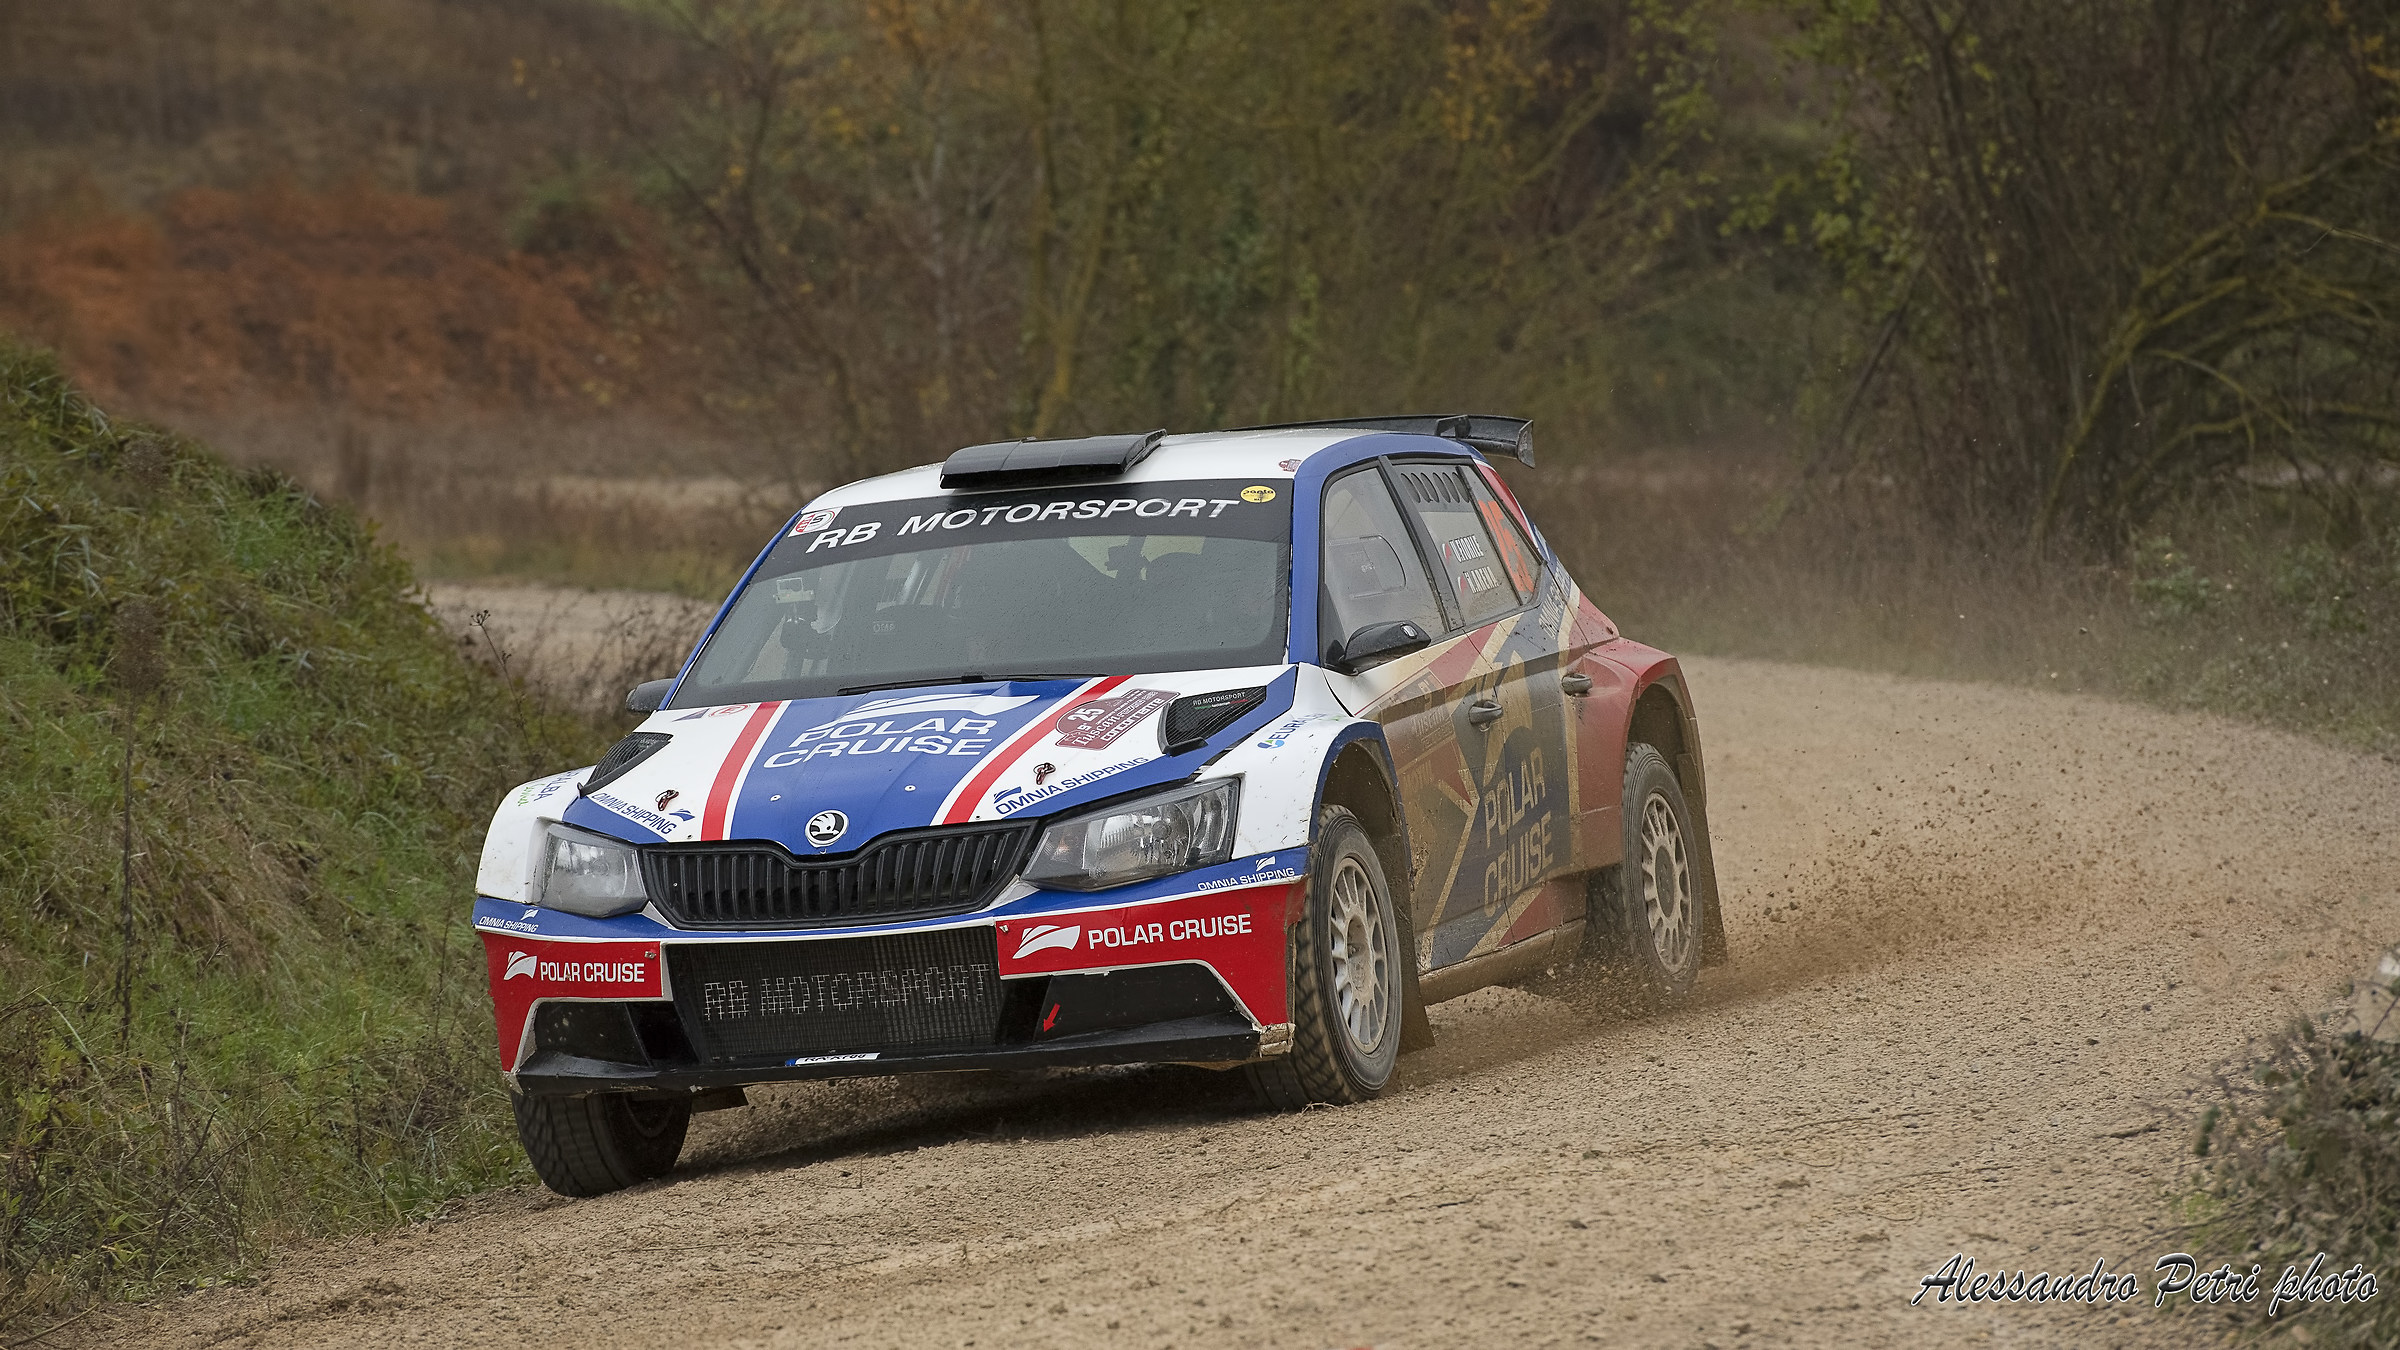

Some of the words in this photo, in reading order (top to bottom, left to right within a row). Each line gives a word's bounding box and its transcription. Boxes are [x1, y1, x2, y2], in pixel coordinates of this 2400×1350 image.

[806, 521, 883, 553] RB
[897, 498, 1240, 536] MOTORSPORT
[1067, 708, 1105, 722] 25
[1203, 691, 1246, 704] MOTORSPORT
[789, 716, 999, 748] POLAR
[1071, 714, 1122, 746] Tuscan
[1101, 698, 1165, 742] concorrente
[763, 735, 992, 769] CRUISE
[994, 784, 1062, 816] OMNIA
[1064, 757, 1149, 791] SHIPPING
[1485, 747, 1547, 848] POLAR
[591, 792, 626, 812] OMNIA
[621, 803, 677, 835] SHIPPING
[1198, 879, 1238, 892] OMNIA
[1239, 866, 1295, 886] SHIPPING
[1484, 811, 1553, 917] CRUISE
[479, 916, 505, 929] OMNIA
[505, 919, 539, 933] SHIPPING
[1088, 923, 1163, 950] POLAR
[1168, 914, 1252, 941] CRUISE
[539, 961, 581, 982] POLAR
[583, 962, 645, 983] CRUISE
[704, 980, 749, 1020] RB
[761, 963, 990, 1016] MOTORSPORT
